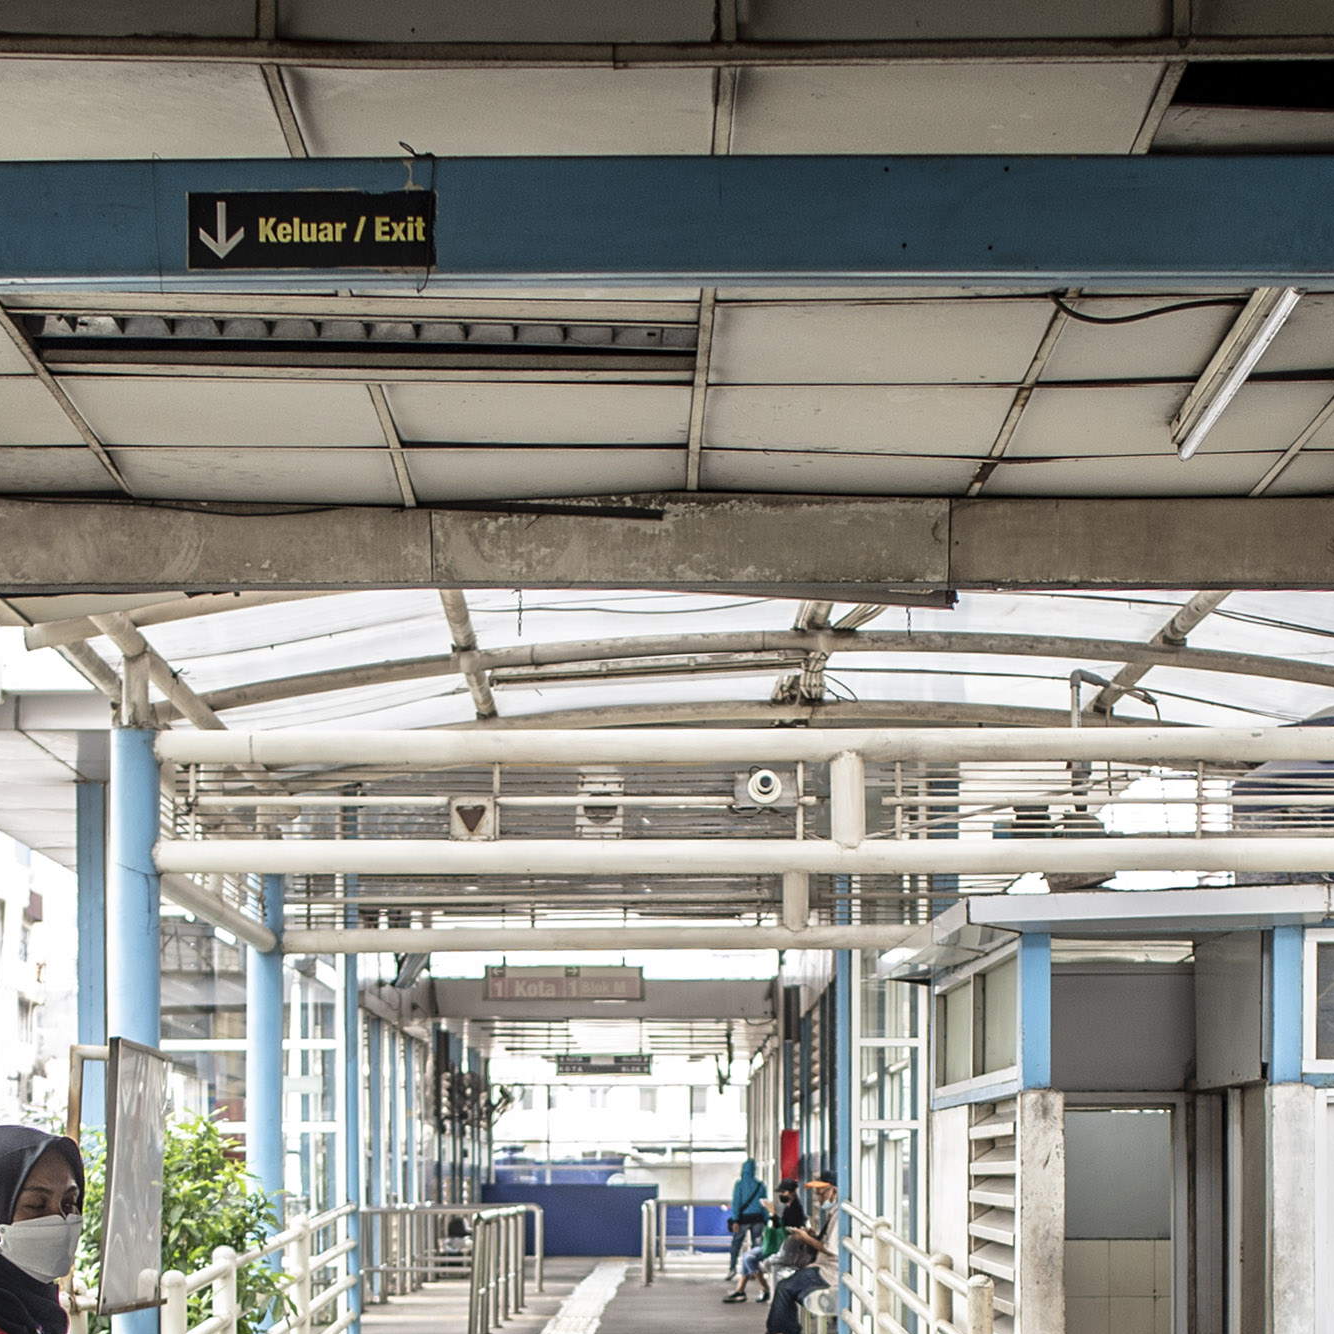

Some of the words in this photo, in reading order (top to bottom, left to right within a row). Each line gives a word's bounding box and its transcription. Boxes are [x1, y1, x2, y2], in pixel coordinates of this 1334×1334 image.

[258, 216, 347, 243] Keluar
[354, 216, 367, 242] /
[374, 216, 426, 242] Exit
[515, 981, 556, 997] Kota
[582, 981, 610, 993] Blok
[614, 982, 626, 993] M
